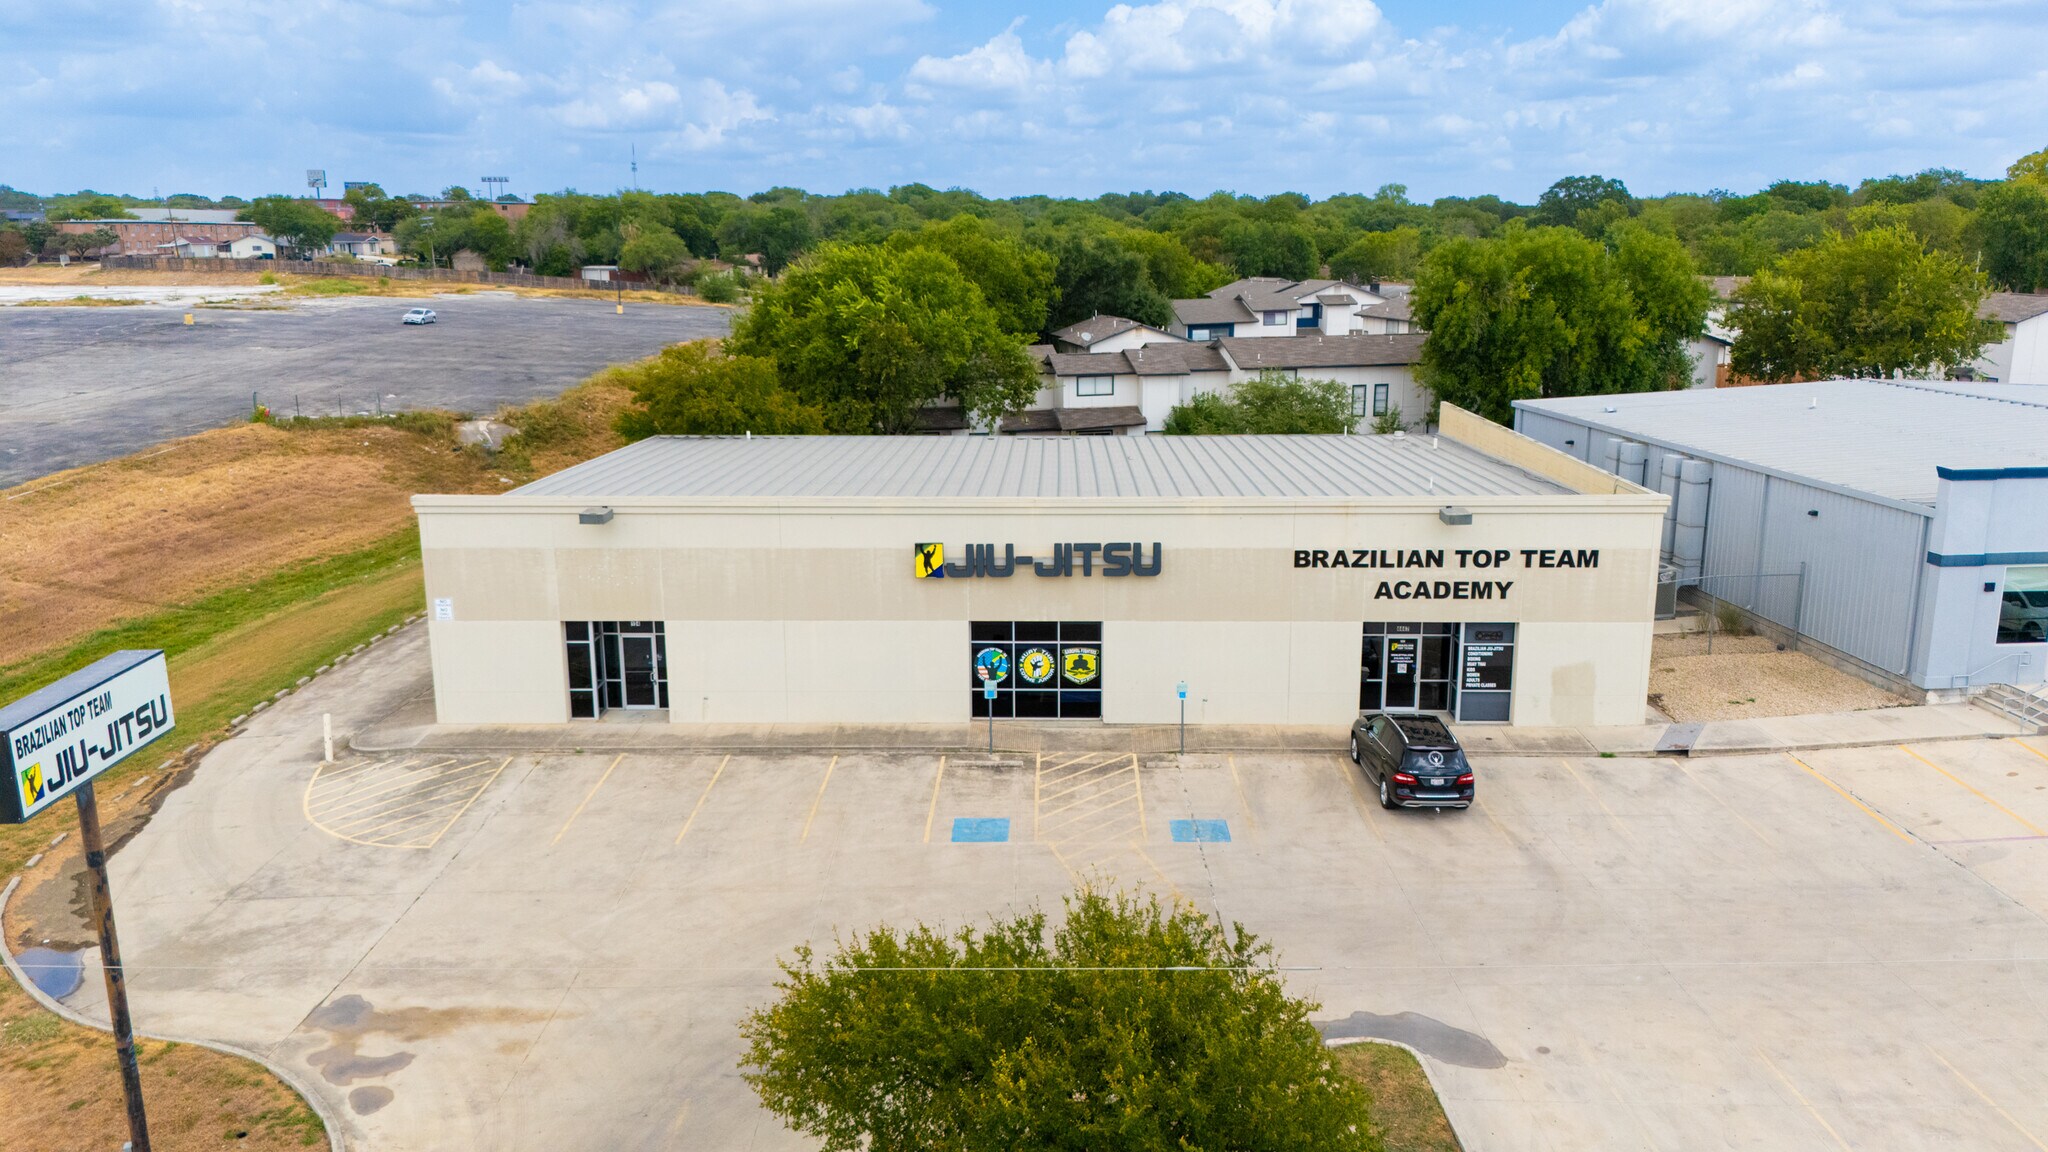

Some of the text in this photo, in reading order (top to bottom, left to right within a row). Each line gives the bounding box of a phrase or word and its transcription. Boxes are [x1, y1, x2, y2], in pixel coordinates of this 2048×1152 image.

[946, 542, 1162, 578] JIU-JITSU
[1293, 549, 1599, 568] BRAZILIAN TOP TEAM
[1374, 581, 1514, 600] ACADEMY
[1020, 648, 1037, 662] MUAY
[1041, 649, 1054, 663] THAI
[15, 690, 113, 760] BRAZILIAN TOP TEAM
[47, 694, 168, 793] JIU-JITSU
